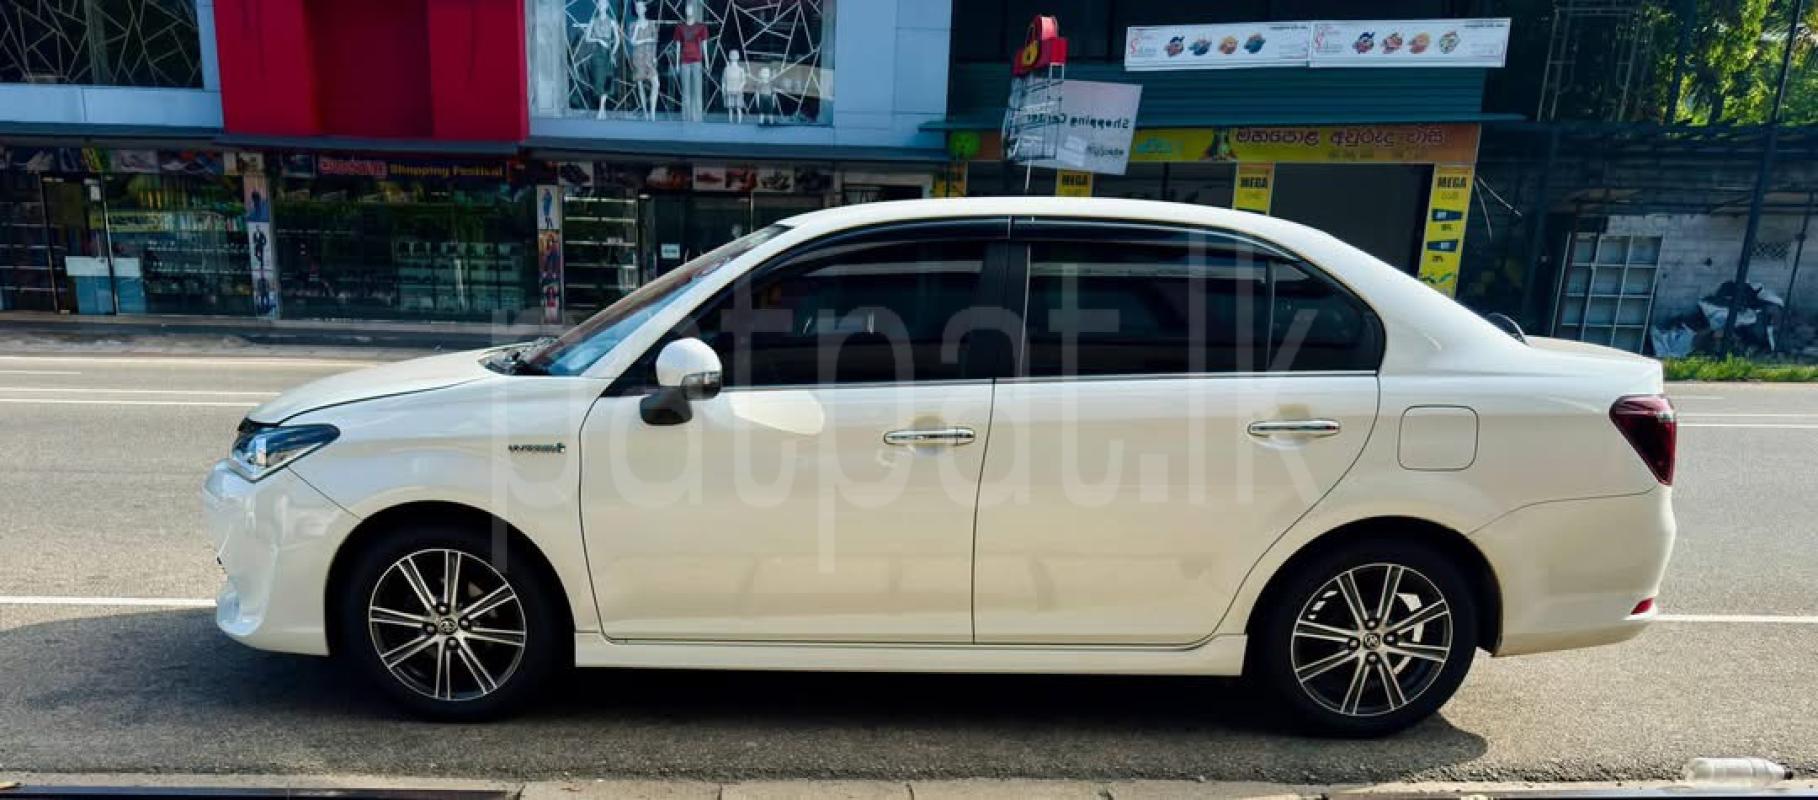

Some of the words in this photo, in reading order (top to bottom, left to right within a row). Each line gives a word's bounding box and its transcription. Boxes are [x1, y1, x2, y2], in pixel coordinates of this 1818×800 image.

[389, 162, 450, 177] Shopping
[452, 164, 503, 177] Festival
[1061, 174, 1089, 187] MEGA
[1239, 175, 1269, 189] MEGA
[1436, 175, 1467, 189] MEGA
